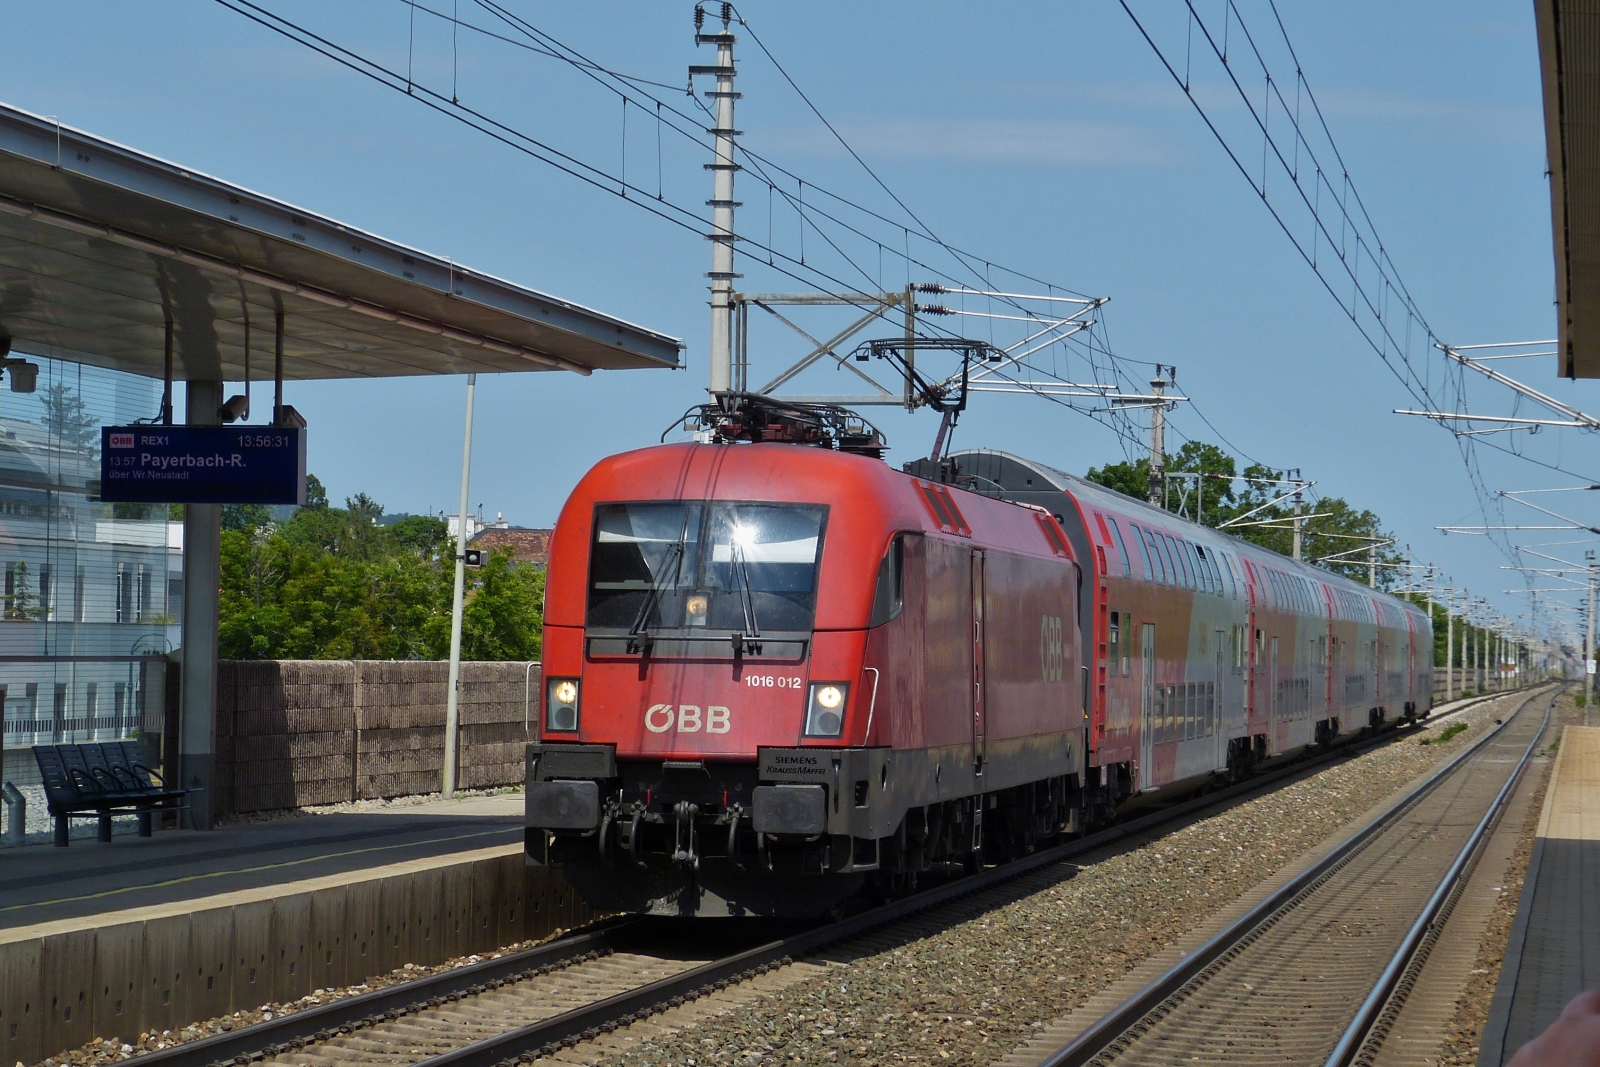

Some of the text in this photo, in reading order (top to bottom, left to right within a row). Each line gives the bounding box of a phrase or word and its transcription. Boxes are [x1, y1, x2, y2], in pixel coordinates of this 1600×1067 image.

[141, 436, 169, 446] REX1
[237, 436, 289, 447] 13:56:31
[109, 453, 246, 470] 13:57 Payerbach-R.
[109, 469, 129, 479] über
[1040, 614, 1063, 682] ÖBB
[745, 675, 802, 689] 1016 012
[644, 703, 731, 734] ÖBB
[775, 756, 818, 765] SIEMENS
